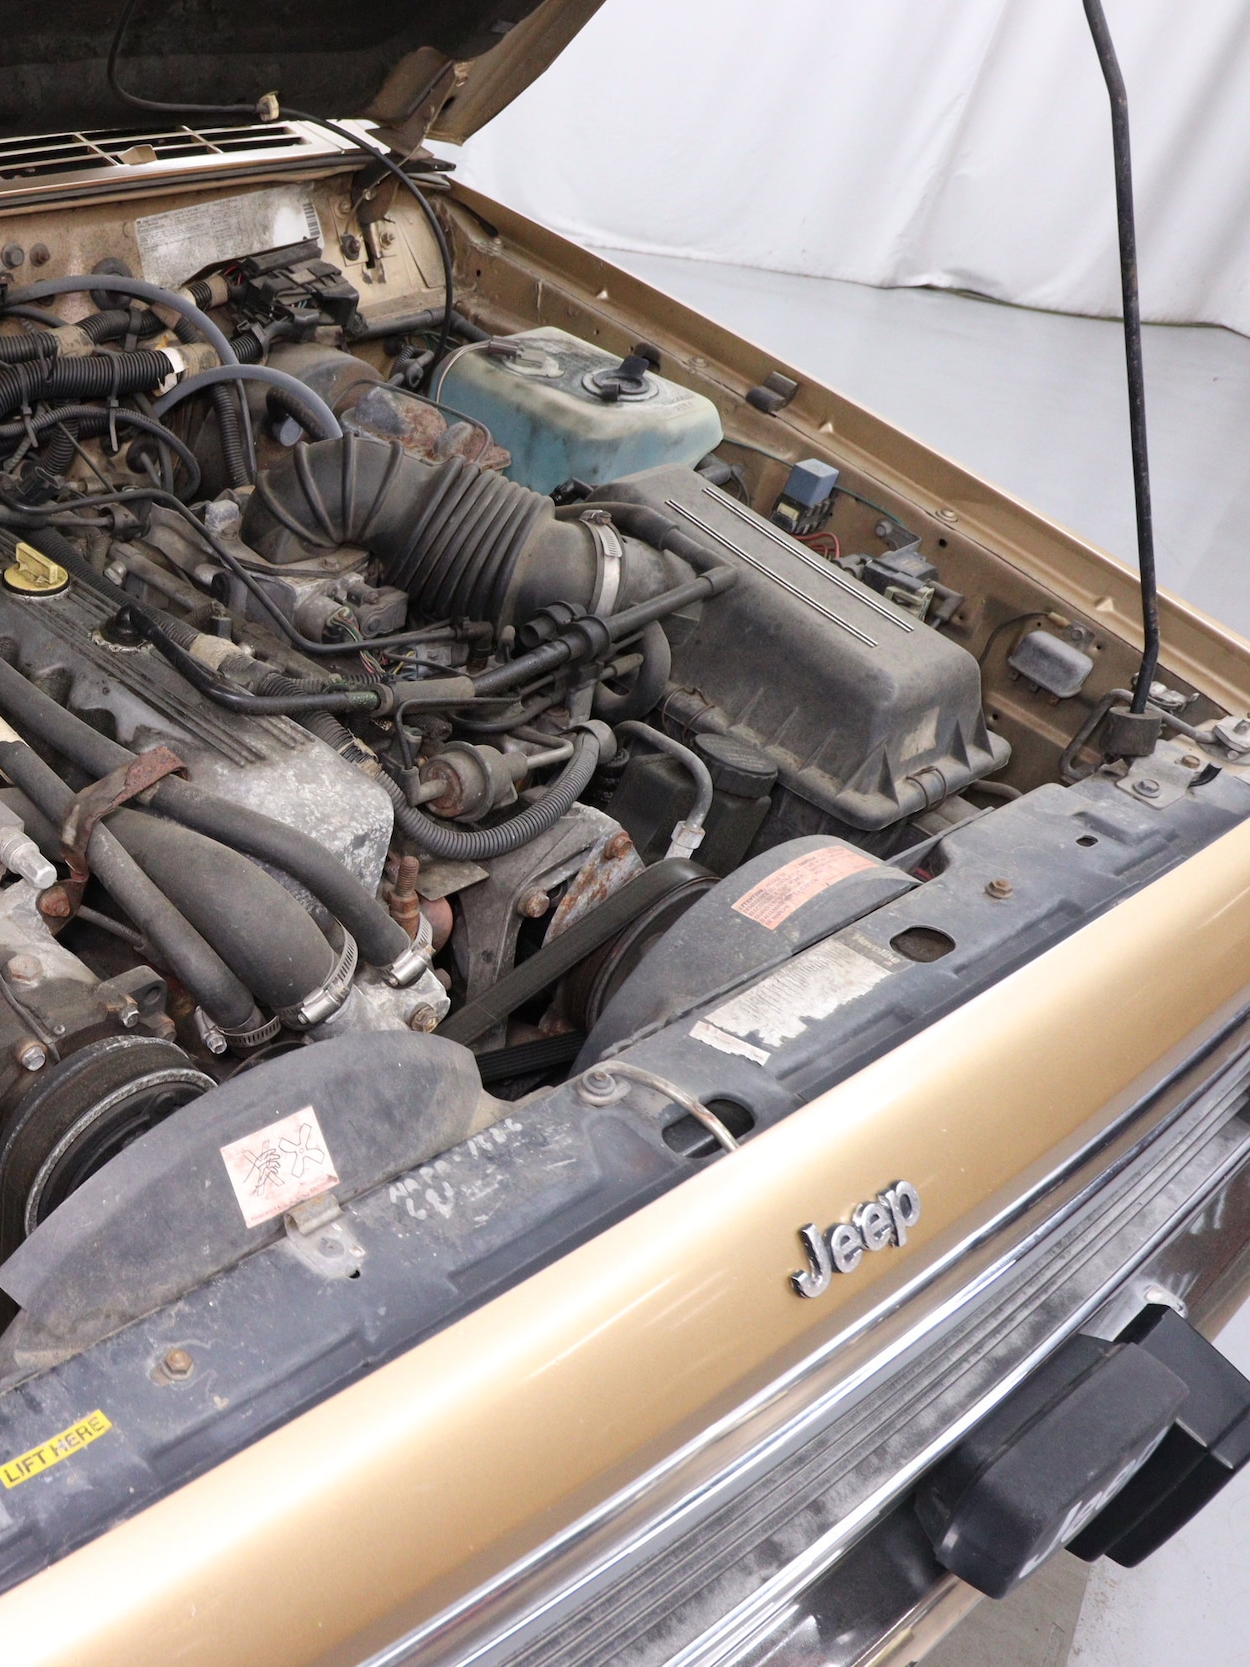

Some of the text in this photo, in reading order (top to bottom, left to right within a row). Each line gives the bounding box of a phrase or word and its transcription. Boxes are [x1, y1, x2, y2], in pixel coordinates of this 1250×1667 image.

[790, 1179, 921, 1298] Jeep
[3, 1416, 105, 1483] LIFT HERE
